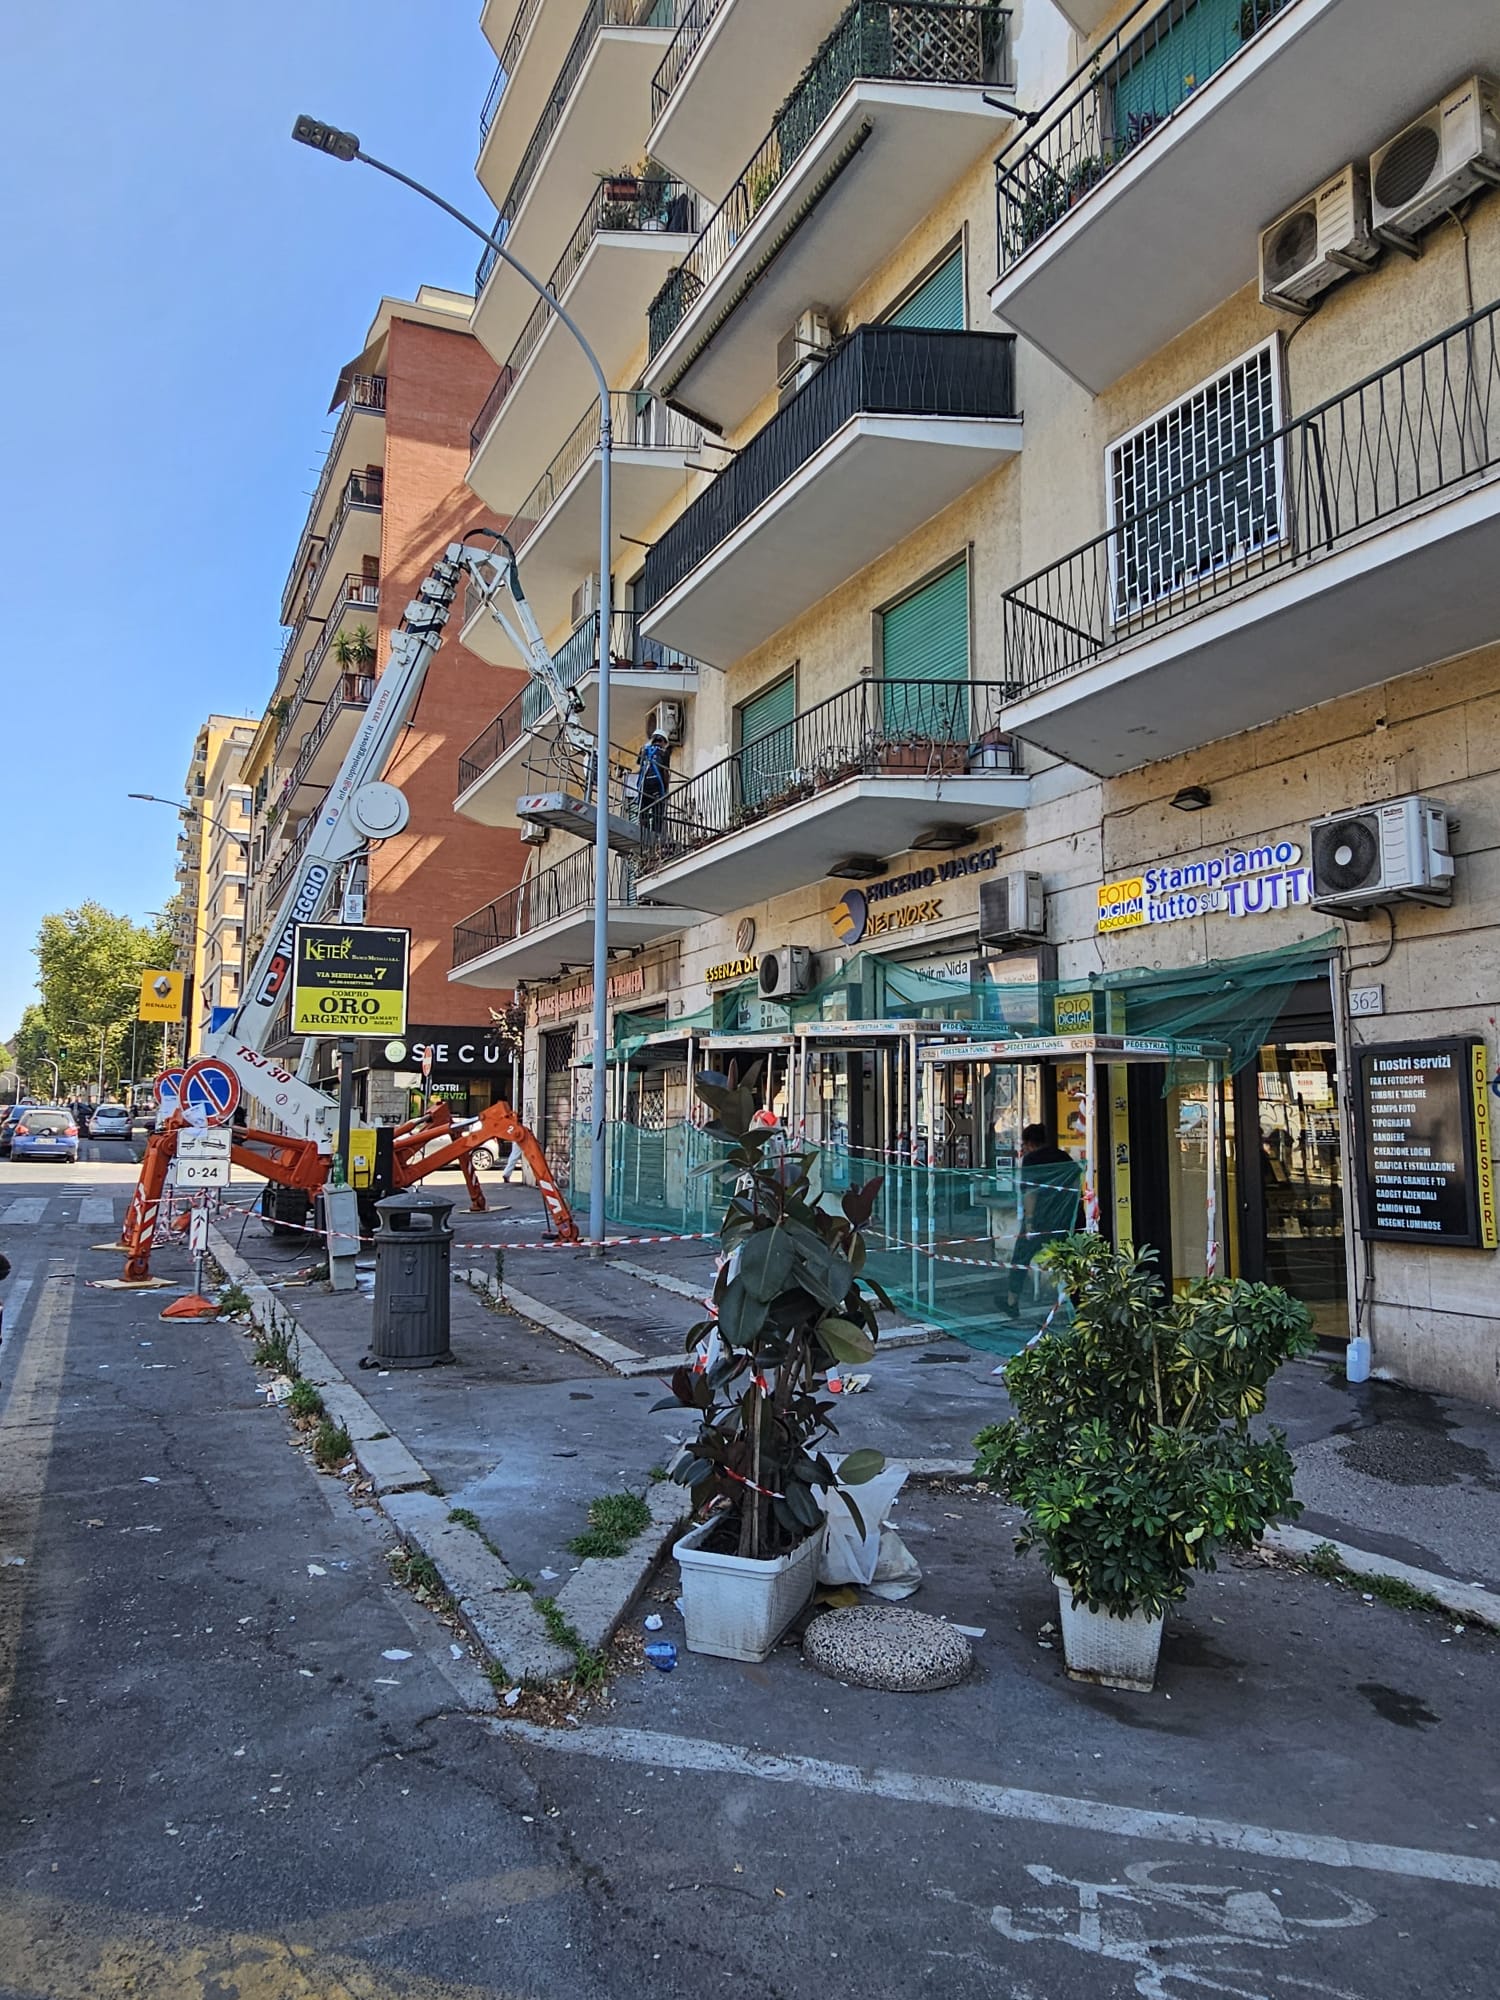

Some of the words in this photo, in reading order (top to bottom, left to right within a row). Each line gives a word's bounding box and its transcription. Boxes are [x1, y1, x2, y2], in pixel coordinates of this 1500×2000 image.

[1145, 842, 1293, 894] Stampiamo
[866, 867, 935, 902] FRIGERIO
[938, 849, 998, 881] VIAGGI
[1099, 880, 1142, 906] FOTO
[1149, 894, 1197, 922] tutto
[1224, 868, 1314, 915] TUTT
[1098, 897, 1143, 920] DIGITAL
[866, 898, 942, 935] NETWORK
[1099, 913, 1142, 930] DISCOUNT
[257, 956, 287, 1003] TOP
[277, 864, 328, 958] NOEGGIO
[304, 937, 349, 960] KETER
[374, 967, 387, 980] 7
[705, 959, 742, 983] ESSENZA
[743, 956, 754, 974] DI
[915, 966, 935, 983] Vivir
[945, 960, 968, 977] Vida
[332, 990, 369, 998] COMPRO
[1351, 990, 1379, 1011] 362
[319, 996, 380, 1015] ORO
[1058, 998, 1089, 1014] FOTO
[300, 1014, 368, 1025] ARGENTO
[1058, 1010, 1091, 1026] DIGITAL
[1058, 1021, 1090, 1033] DISCOUNT
[940, 1047, 969, 1056] PEDESTRIAN
[969, 1045, 990, 1054] TUNNEL
[1007, 1041, 1040, 1052] PEDESTRIAN
[1041, 1040, 1064, 1049] TUNNEL
[1125, 1040, 1170, 1049] PEDESTRIAN
[1174, 1043, 1201, 1051] UNNEL
[236, 1046, 267, 1068] TSJ
[267, 1066, 291, 1084] 30
[1374, 1058, 1378, 1071] i
[1379, 1057, 1411, 1071] nostri
[1413, 1054, 1452, 1069] servizi
[431, 1083, 459, 1091] OSTRI
[1388, 1075, 1424, 1086] FOTOCOPIE
[1371, 1091, 1395, 1099] TIMBRI
[1400, 1089, 1427, 1098] TARGHE
[1371, 1104, 1399, 1114] STAMPA
[1399, 1104, 1416, 1113] FOTO
[1372, 1118, 1411, 1128] TIPOGRAFIA
[506, 1125, 514, 1135] 2
[1373, 1132, 1405, 1142] BANDIERE
[1374, 1147, 1409, 1156] CREAZIONE
[1410, 1147, 1431, 1157] LOGHI
[1475, 1051, 1495, 1242] FOTOTESSERE
[1375, 1160, 1403, 1170] GRAFICA
[1408, 1162, 1456, 1172] ISTALLAZIONE
[187, 1167, 218, 1179] 0-24
[1375, 1174, 1402, 1184] STAMPA
[1402, 1175, 1430, 1186] GRANDE
[1376, 1189, 1401, 1199] GADGET
[1402, 1190, 1437, 1200] AZIENDALI
[1376, 1203, 1403, 1213] CAMION
[1404, 1205, 1421, 1214] VELA
[1377, 1217, 1405, 1228] INSEGNE
[1406, 1219, 1442, 1230] LUMINOSE
